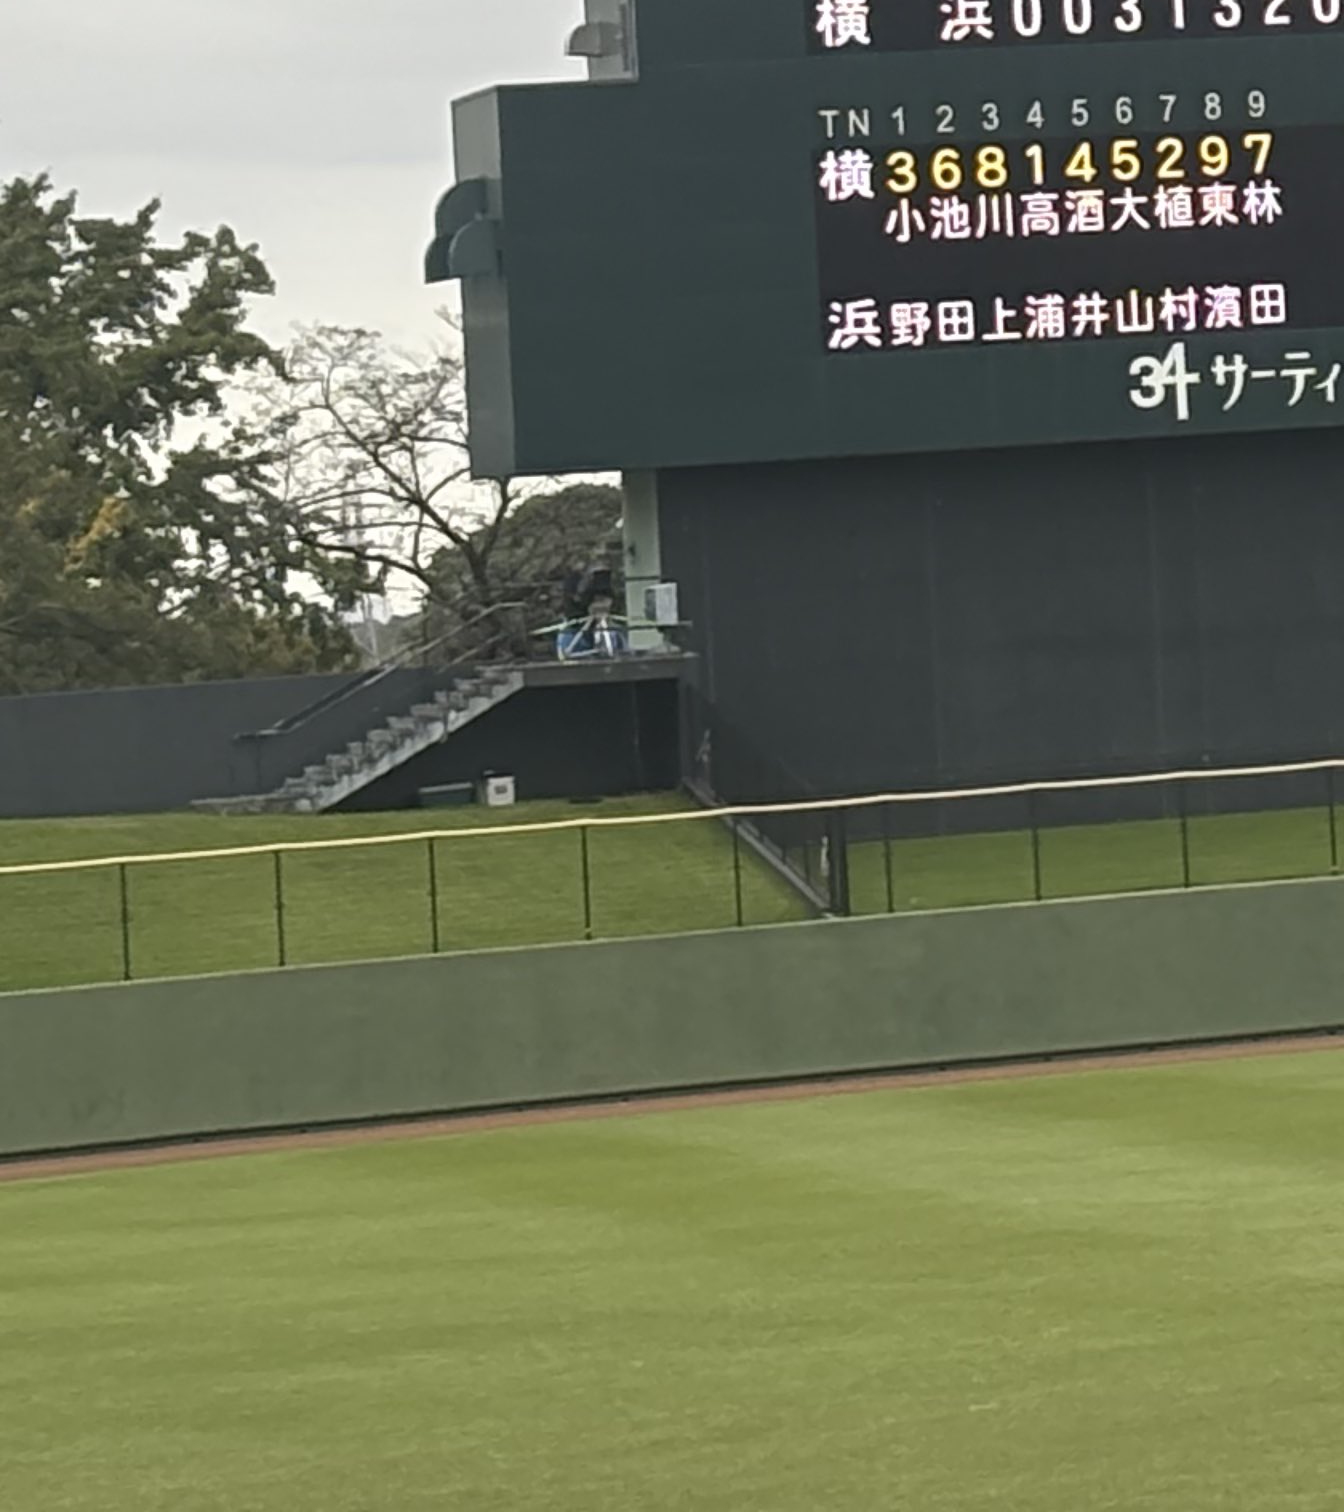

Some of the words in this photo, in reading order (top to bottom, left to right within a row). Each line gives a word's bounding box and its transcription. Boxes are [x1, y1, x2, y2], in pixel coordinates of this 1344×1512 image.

[819, 109, 869, 137] TN
[892, 107, 904, 134] 1
[936, 105, 954, 132] 2
[982, 103, 999, 130] 3
[1027, 101, 1044, 128] 4
[1072, 99, 1088, 126] 5
[1116, 97, 1132, 124] 6
[1160, 95, 1176, 121] 7
[1205, 93, 1221, 120] 8
[1248, 91, 1265, 117] 9
[887, 152, 916, 192] 3
[932, 148, 961, 189] 6
[977, 146, 1007, 187] 8
[1026, 145, 1043, 184] 1
[1065, 142, 1096, 182] 4
[1113, 140, 1140, 180] 5
[1156, 137, 1184, 178] 2
[1200, 136, 1228, 176] 9
[1244, 134, 1271, 174] 7
[1129, 342, 1200, 420] 34
